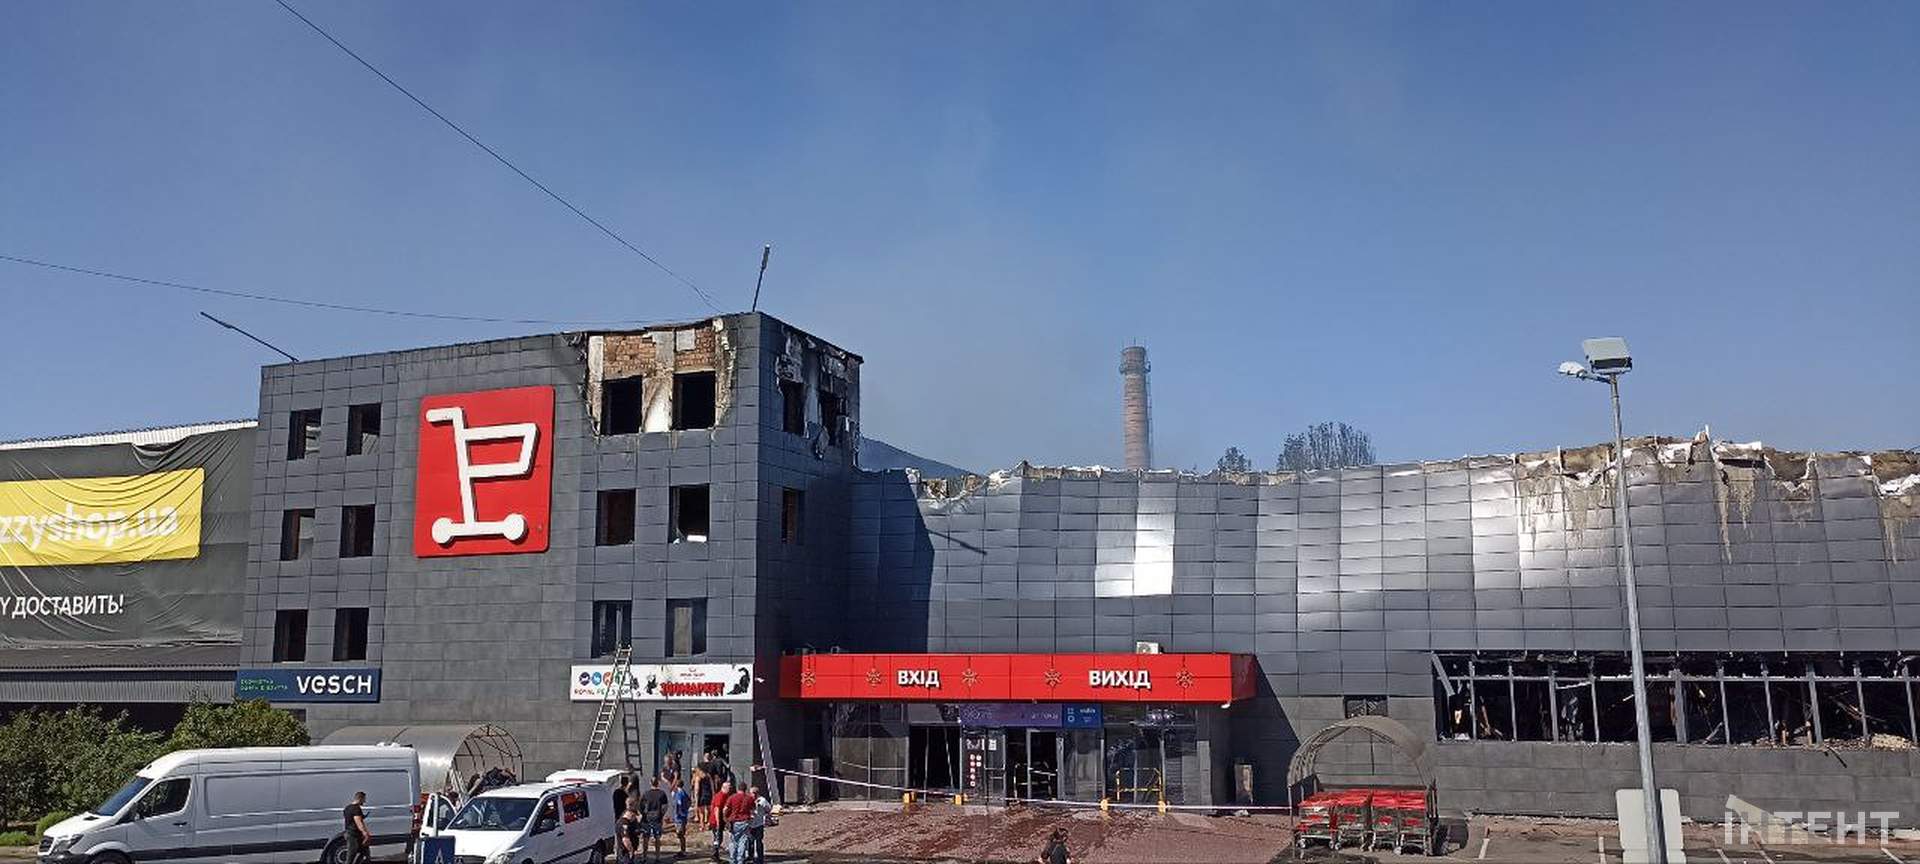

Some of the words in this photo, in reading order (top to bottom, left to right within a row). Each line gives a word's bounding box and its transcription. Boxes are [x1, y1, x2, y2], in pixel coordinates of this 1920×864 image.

[12, 594, 125, 619] ДОСТАВИТЬ!
[897, 669, 940, 689] ВХІД
[1088, 669, 1152, 690] ВИХІД
